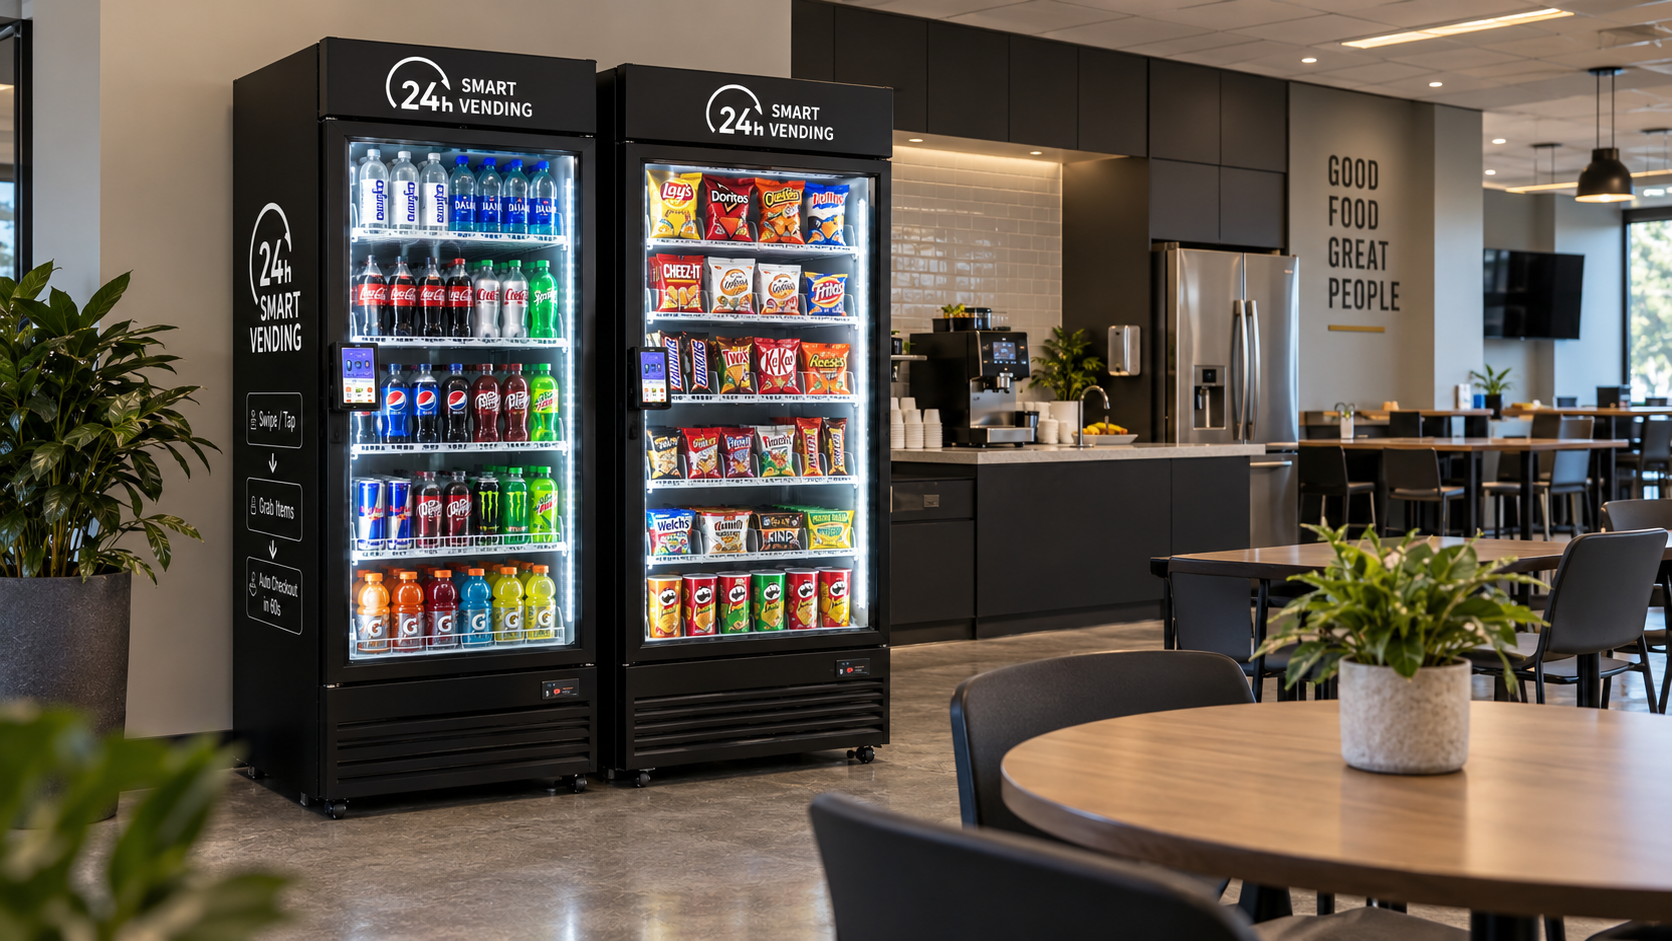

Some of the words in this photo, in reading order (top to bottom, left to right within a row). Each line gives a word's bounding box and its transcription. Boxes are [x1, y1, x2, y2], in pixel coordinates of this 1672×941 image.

[401, 80, 453, 112] 24h
[461, 77, 517, 96] SMART
[459, 98, 533, 118] VENDING
[771, 103, 820, 121] SMART
[718, 106, 764, 136] 24h
[769, 122, 834, 141] VENDING
[1328, 154, 1379, 190] GOOD
[663, 182, 693, 204] Lay's
[711, 190, 749, 204] Doritos
[1328, 195, 1379, 230] FOOD
[259, 239, 292, 287] 24h
[1328, 236, 1389, 271] GREAT
[663, 263, 701, 279] CHEEZ-IT
[814, 282, 844, 301] Fritos
[1328, 277, 1400, 311] PEOPLE
[260, 291, 301, 322] SMART
[250, 323, 302, 353] VENDING
[259, 410, 278, 432] Swipe
[283, 411, 296, 432] Tap
[259, 497, 275, 516] Grab
[275, 500, 295, 520] Items
[271, 575, 298, 598] Checkout
[263, 595, 270, 613] in
[270, 598, 281, 617] 60s
[367, 619, 383, 637] G
[402, 618, 418, 635] G
[437, 615, 452, 632] G
[471, 613, 486, 631] G
[504, 611, 521, 629] G
[537, 610, 553, 627] G
